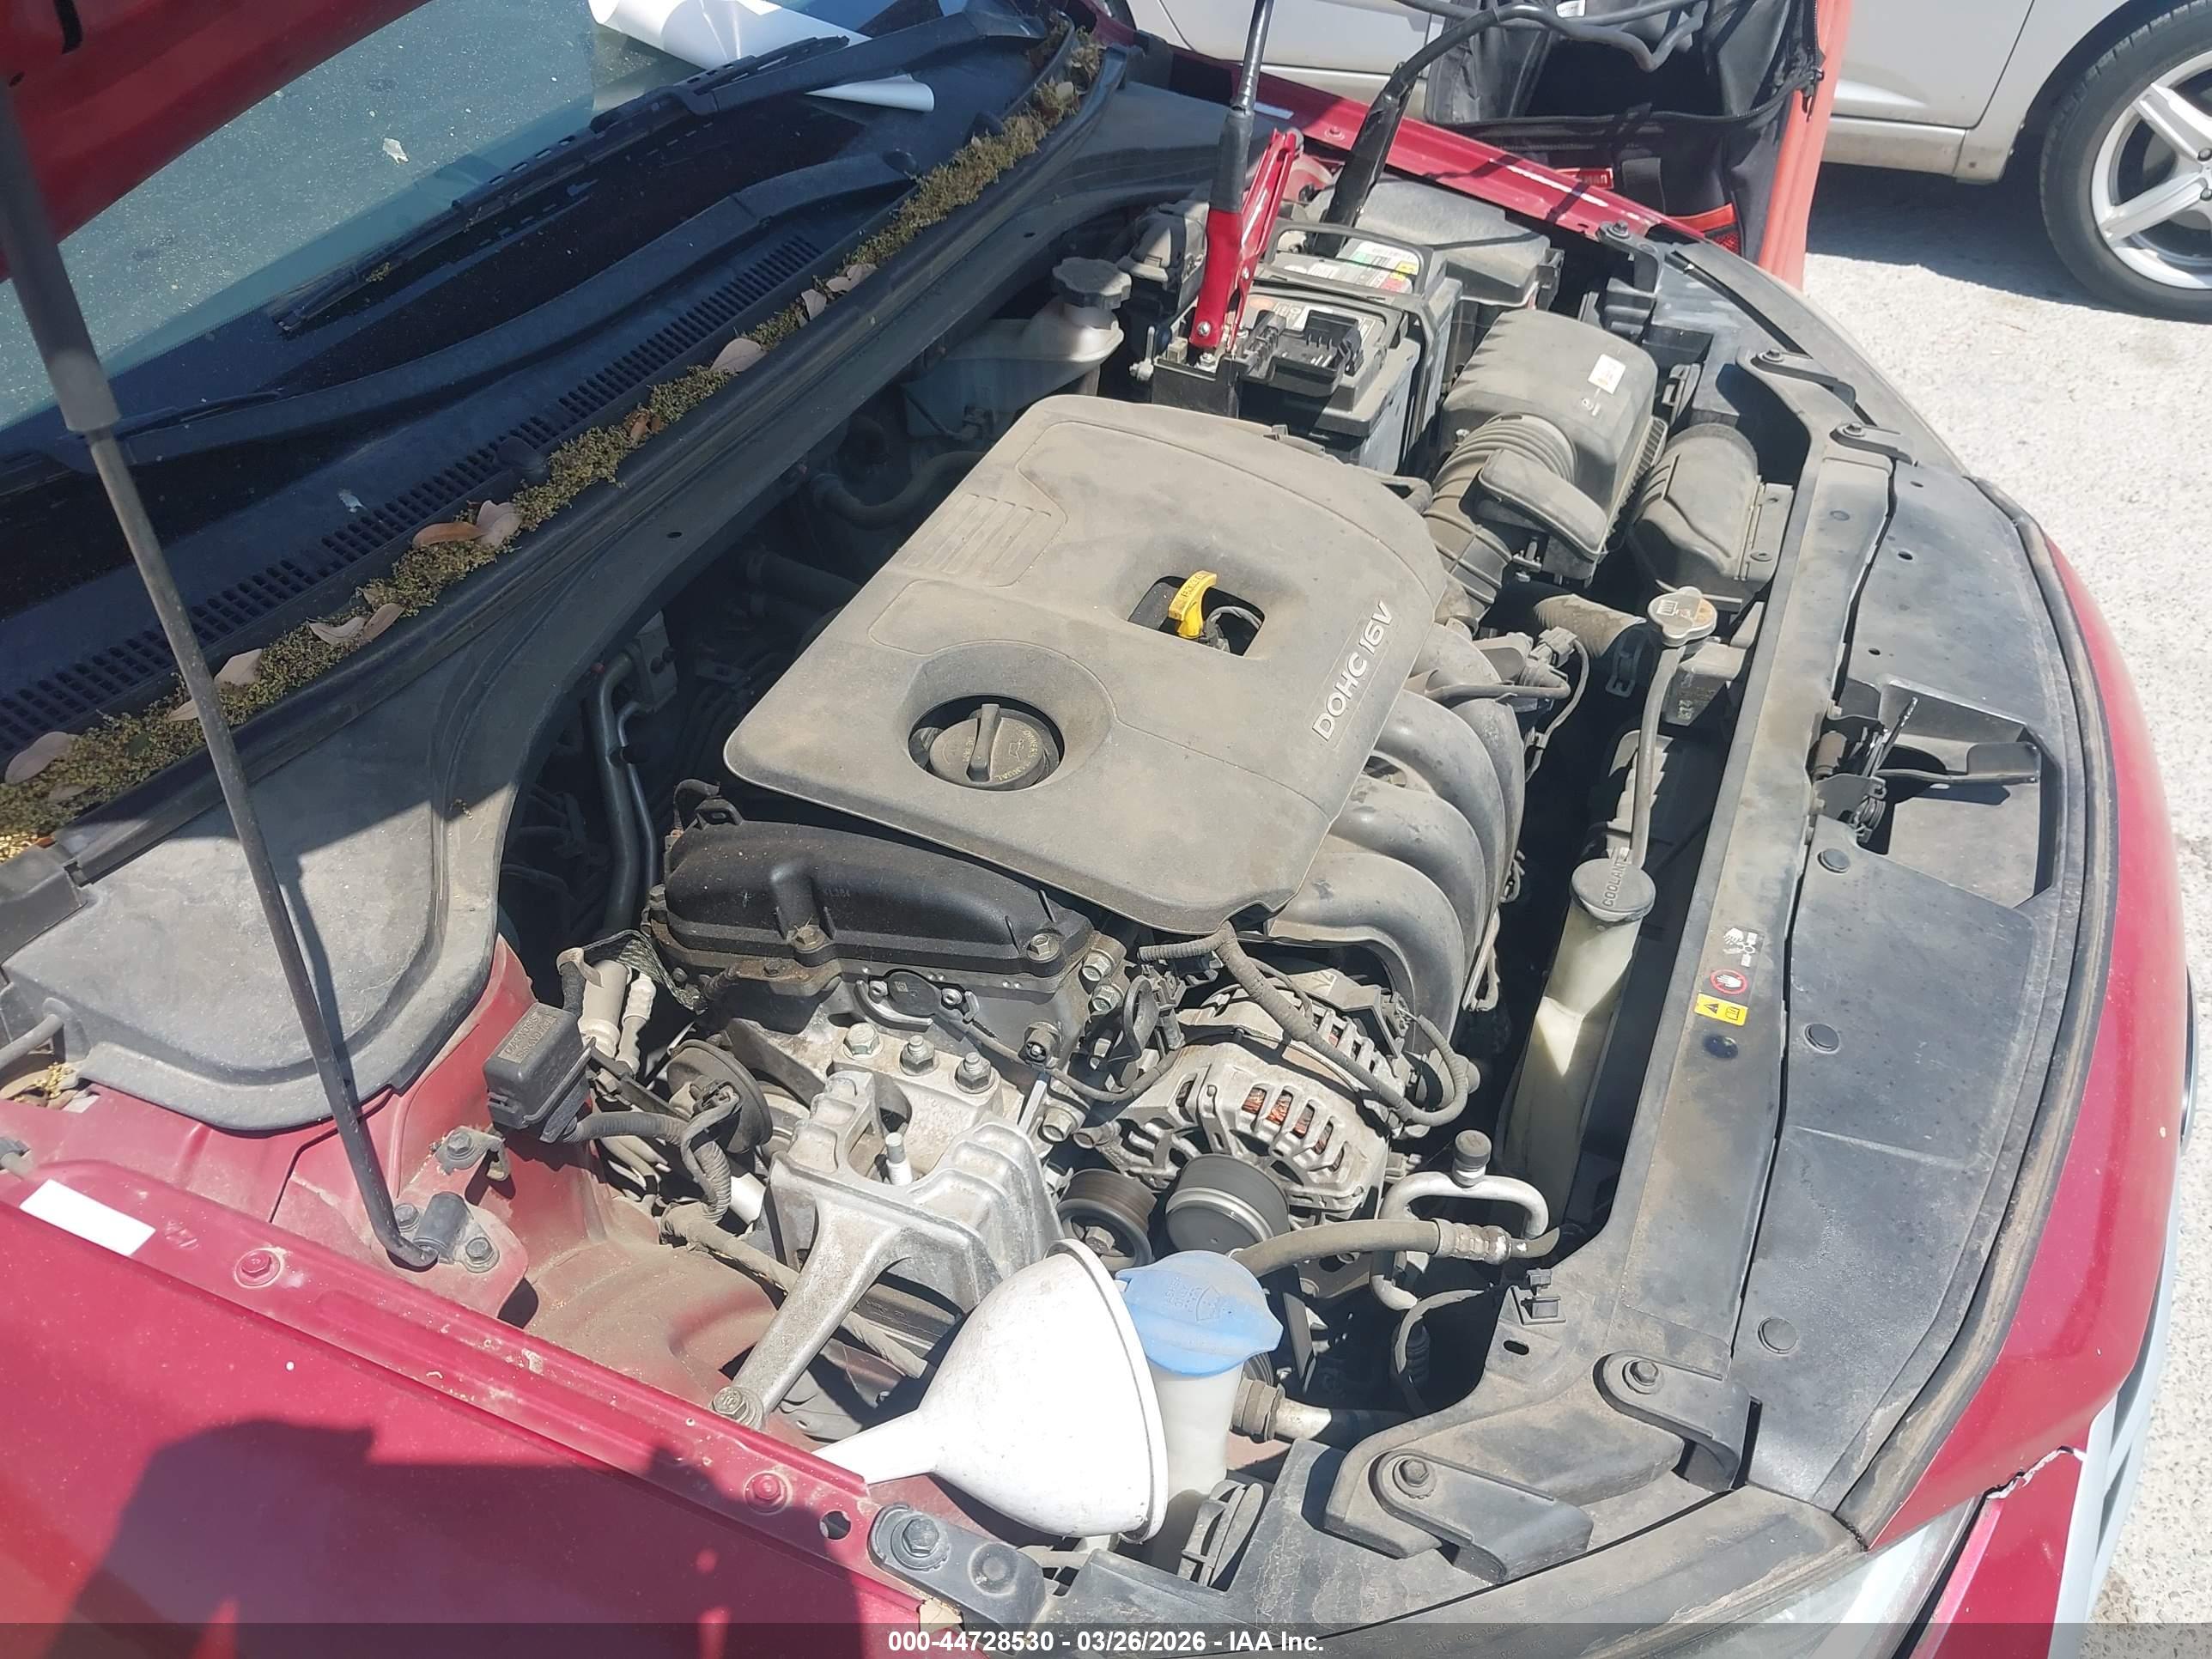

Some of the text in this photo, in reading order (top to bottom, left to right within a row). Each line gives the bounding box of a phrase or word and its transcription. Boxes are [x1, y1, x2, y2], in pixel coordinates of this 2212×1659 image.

[1311, 599, 1394, 743] DOHC 16V
[1601, 858, 1629, 908] COOLANT
[503, 1015, 540, 1056] DIAGNOSIS
